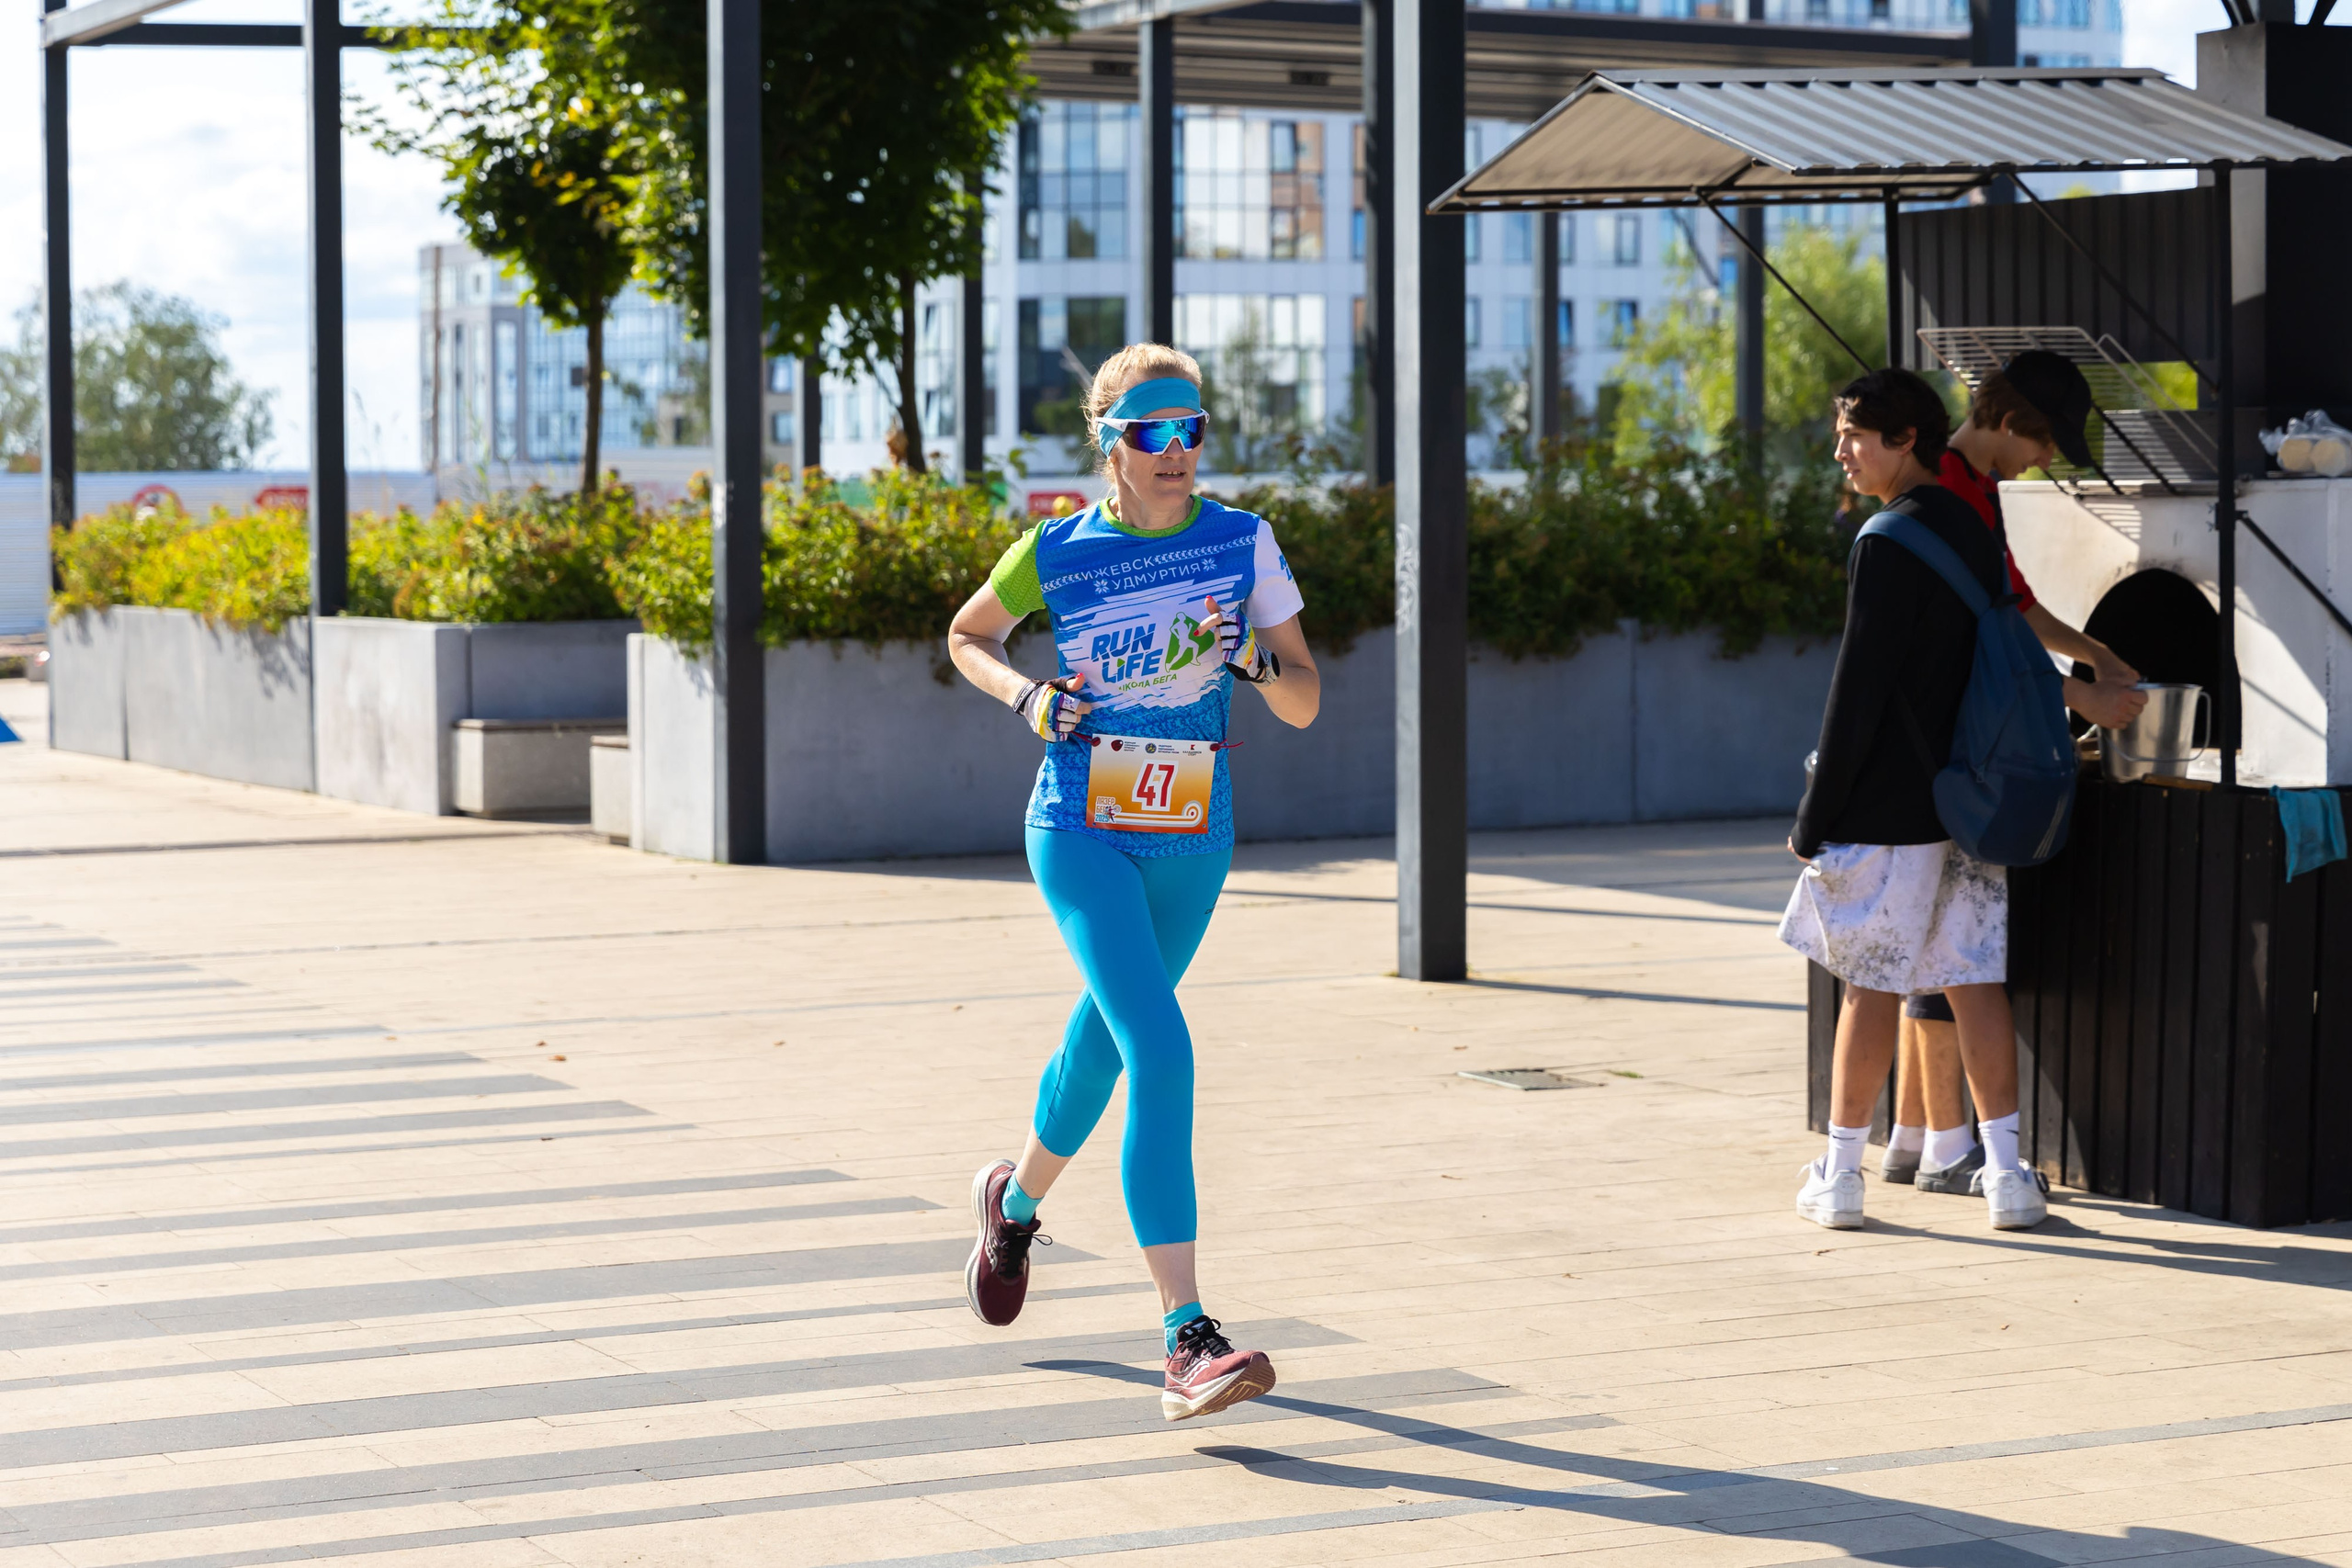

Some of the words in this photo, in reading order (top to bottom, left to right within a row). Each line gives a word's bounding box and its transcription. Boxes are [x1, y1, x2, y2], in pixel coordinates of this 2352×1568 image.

[1081, 556, 1155, 581] ИЖЕВСК
[1112, 562, 1201, 590] УДМУРТИЯ
[1091, 623, 1156, 662] RUN
[1102, 648, 1163, 683] LIFE
[1152, 673, 1178, 685] БЕГА
[1136, 762, 1174, 807] 47
[1095, 814, 1110, 822] 2025
